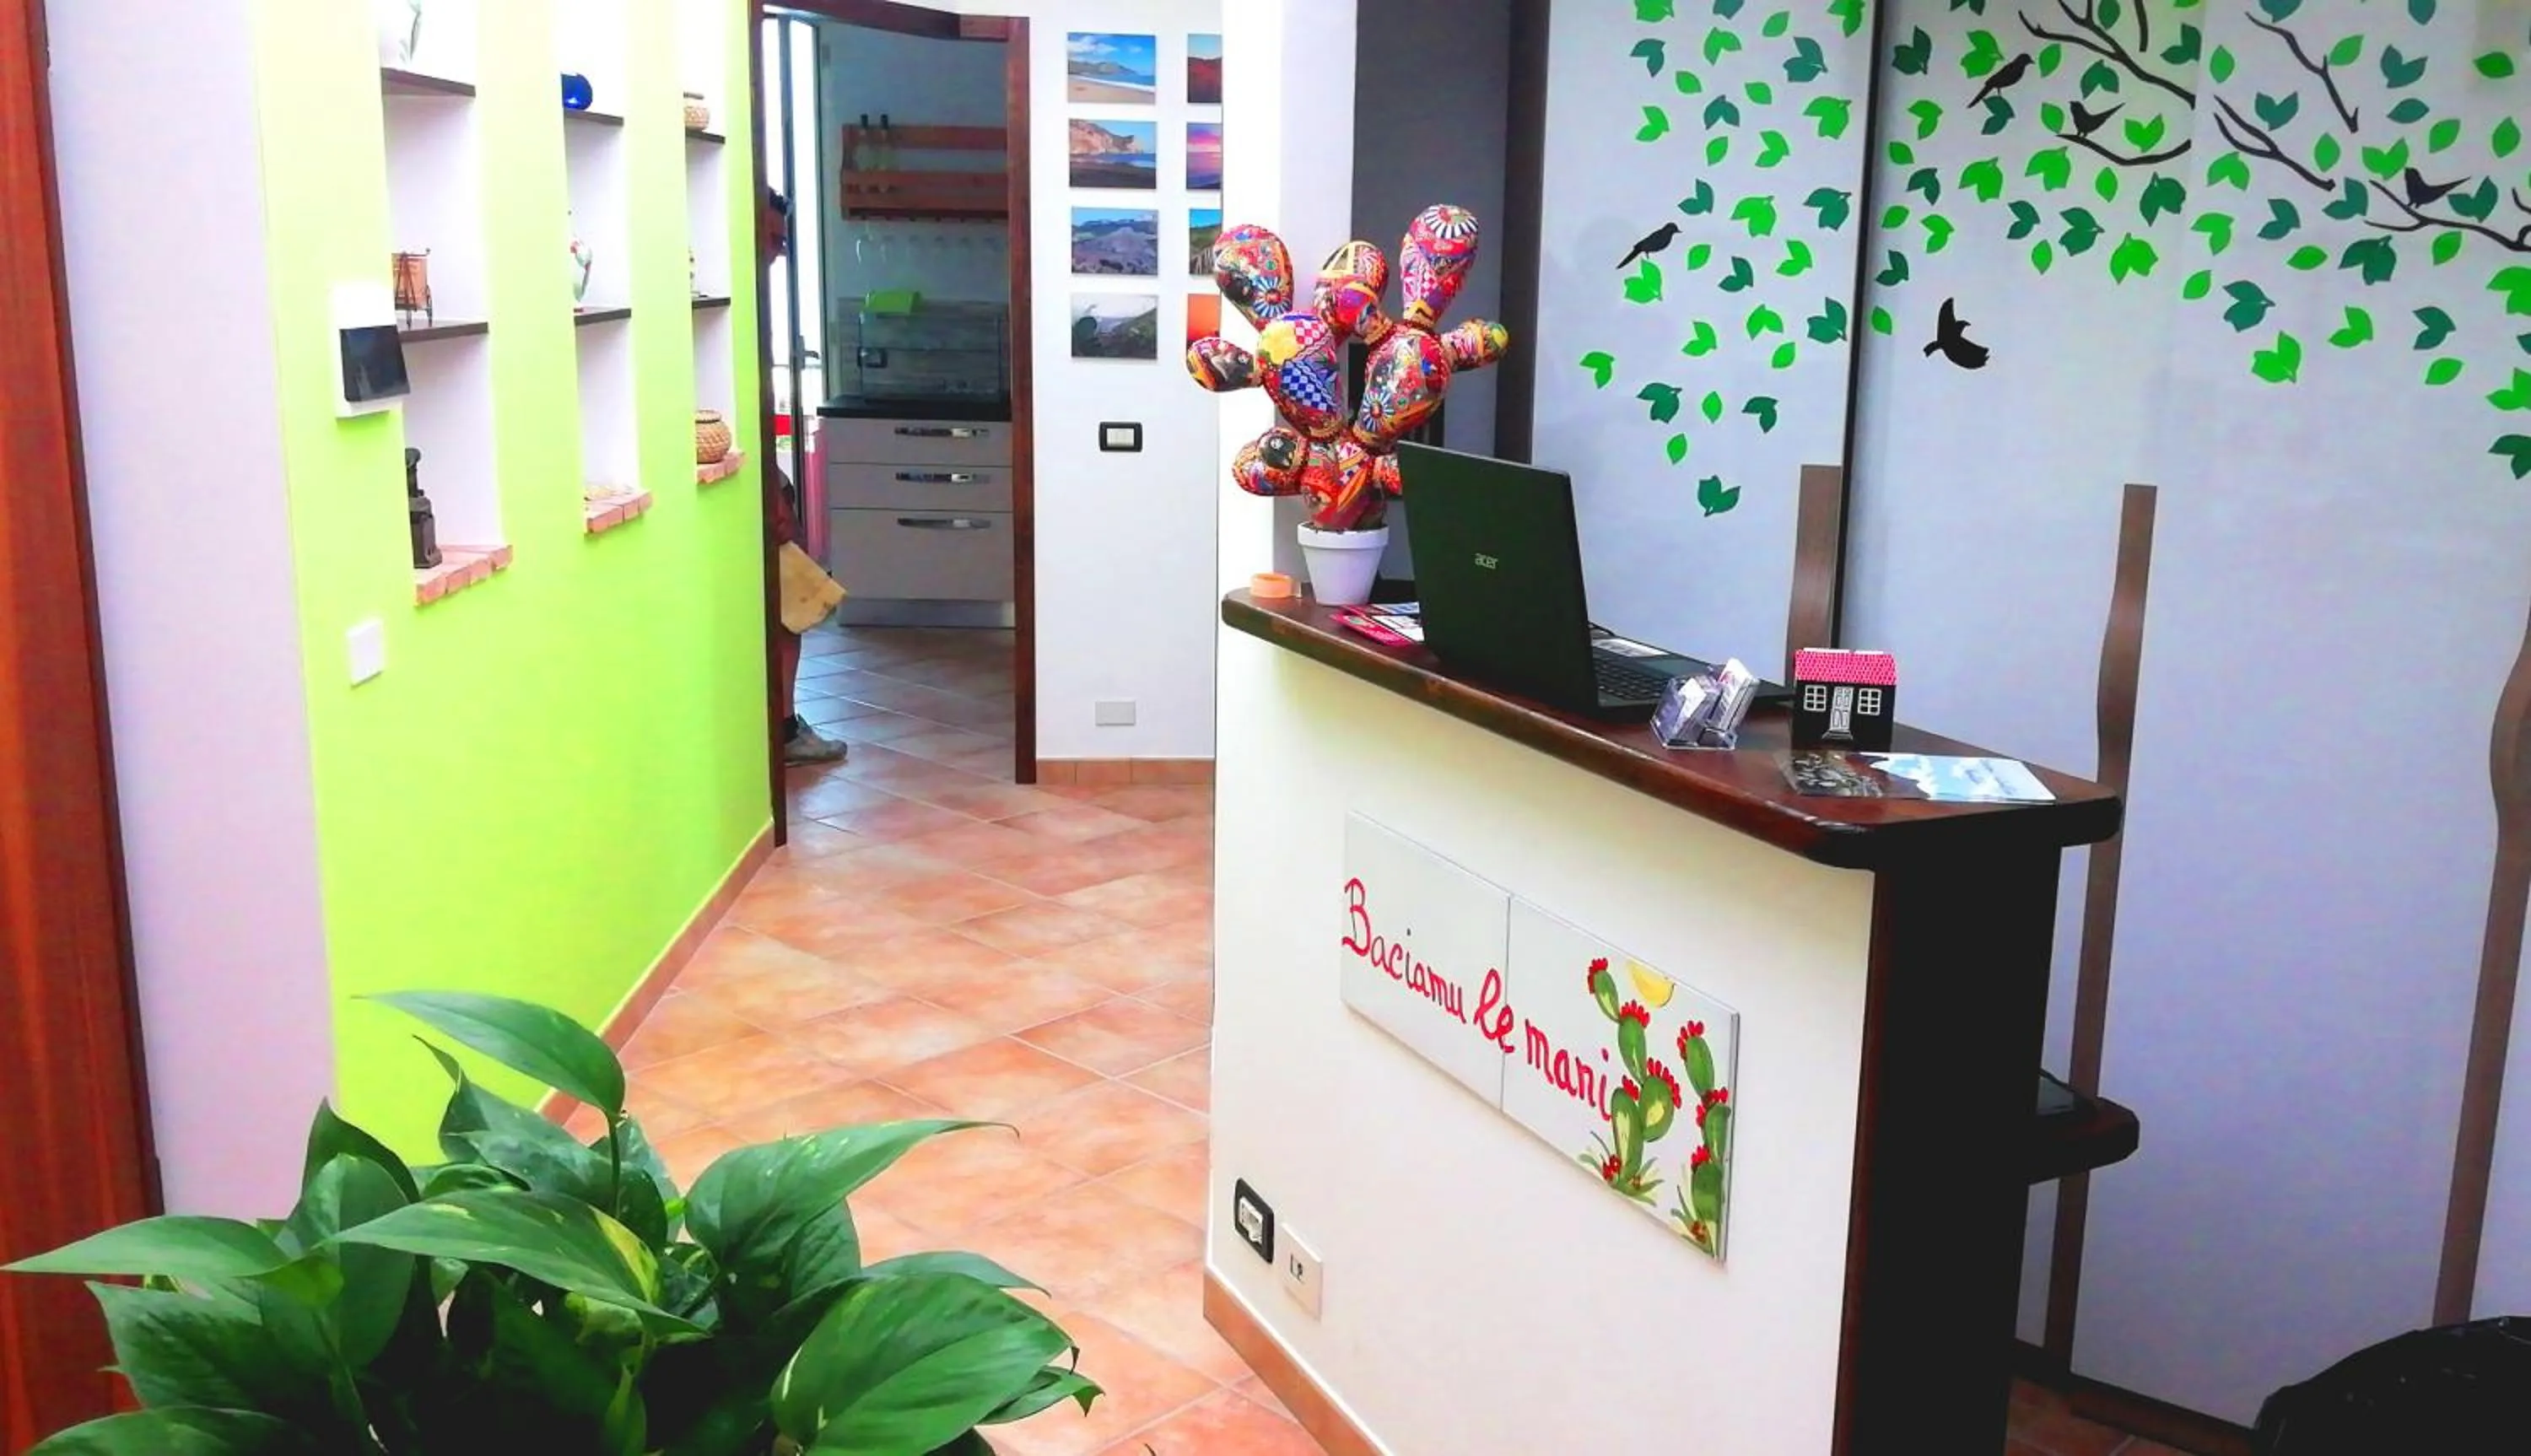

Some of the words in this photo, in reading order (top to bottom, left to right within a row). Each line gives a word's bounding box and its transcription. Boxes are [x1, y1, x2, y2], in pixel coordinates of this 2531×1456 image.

[1474, 553, 1498, 569] acer
[1341, 877, 1467, 1024] Baciamu
[1473, 968, 1516, 1054] le
[1525, 1018, 1611, 1121] mani
